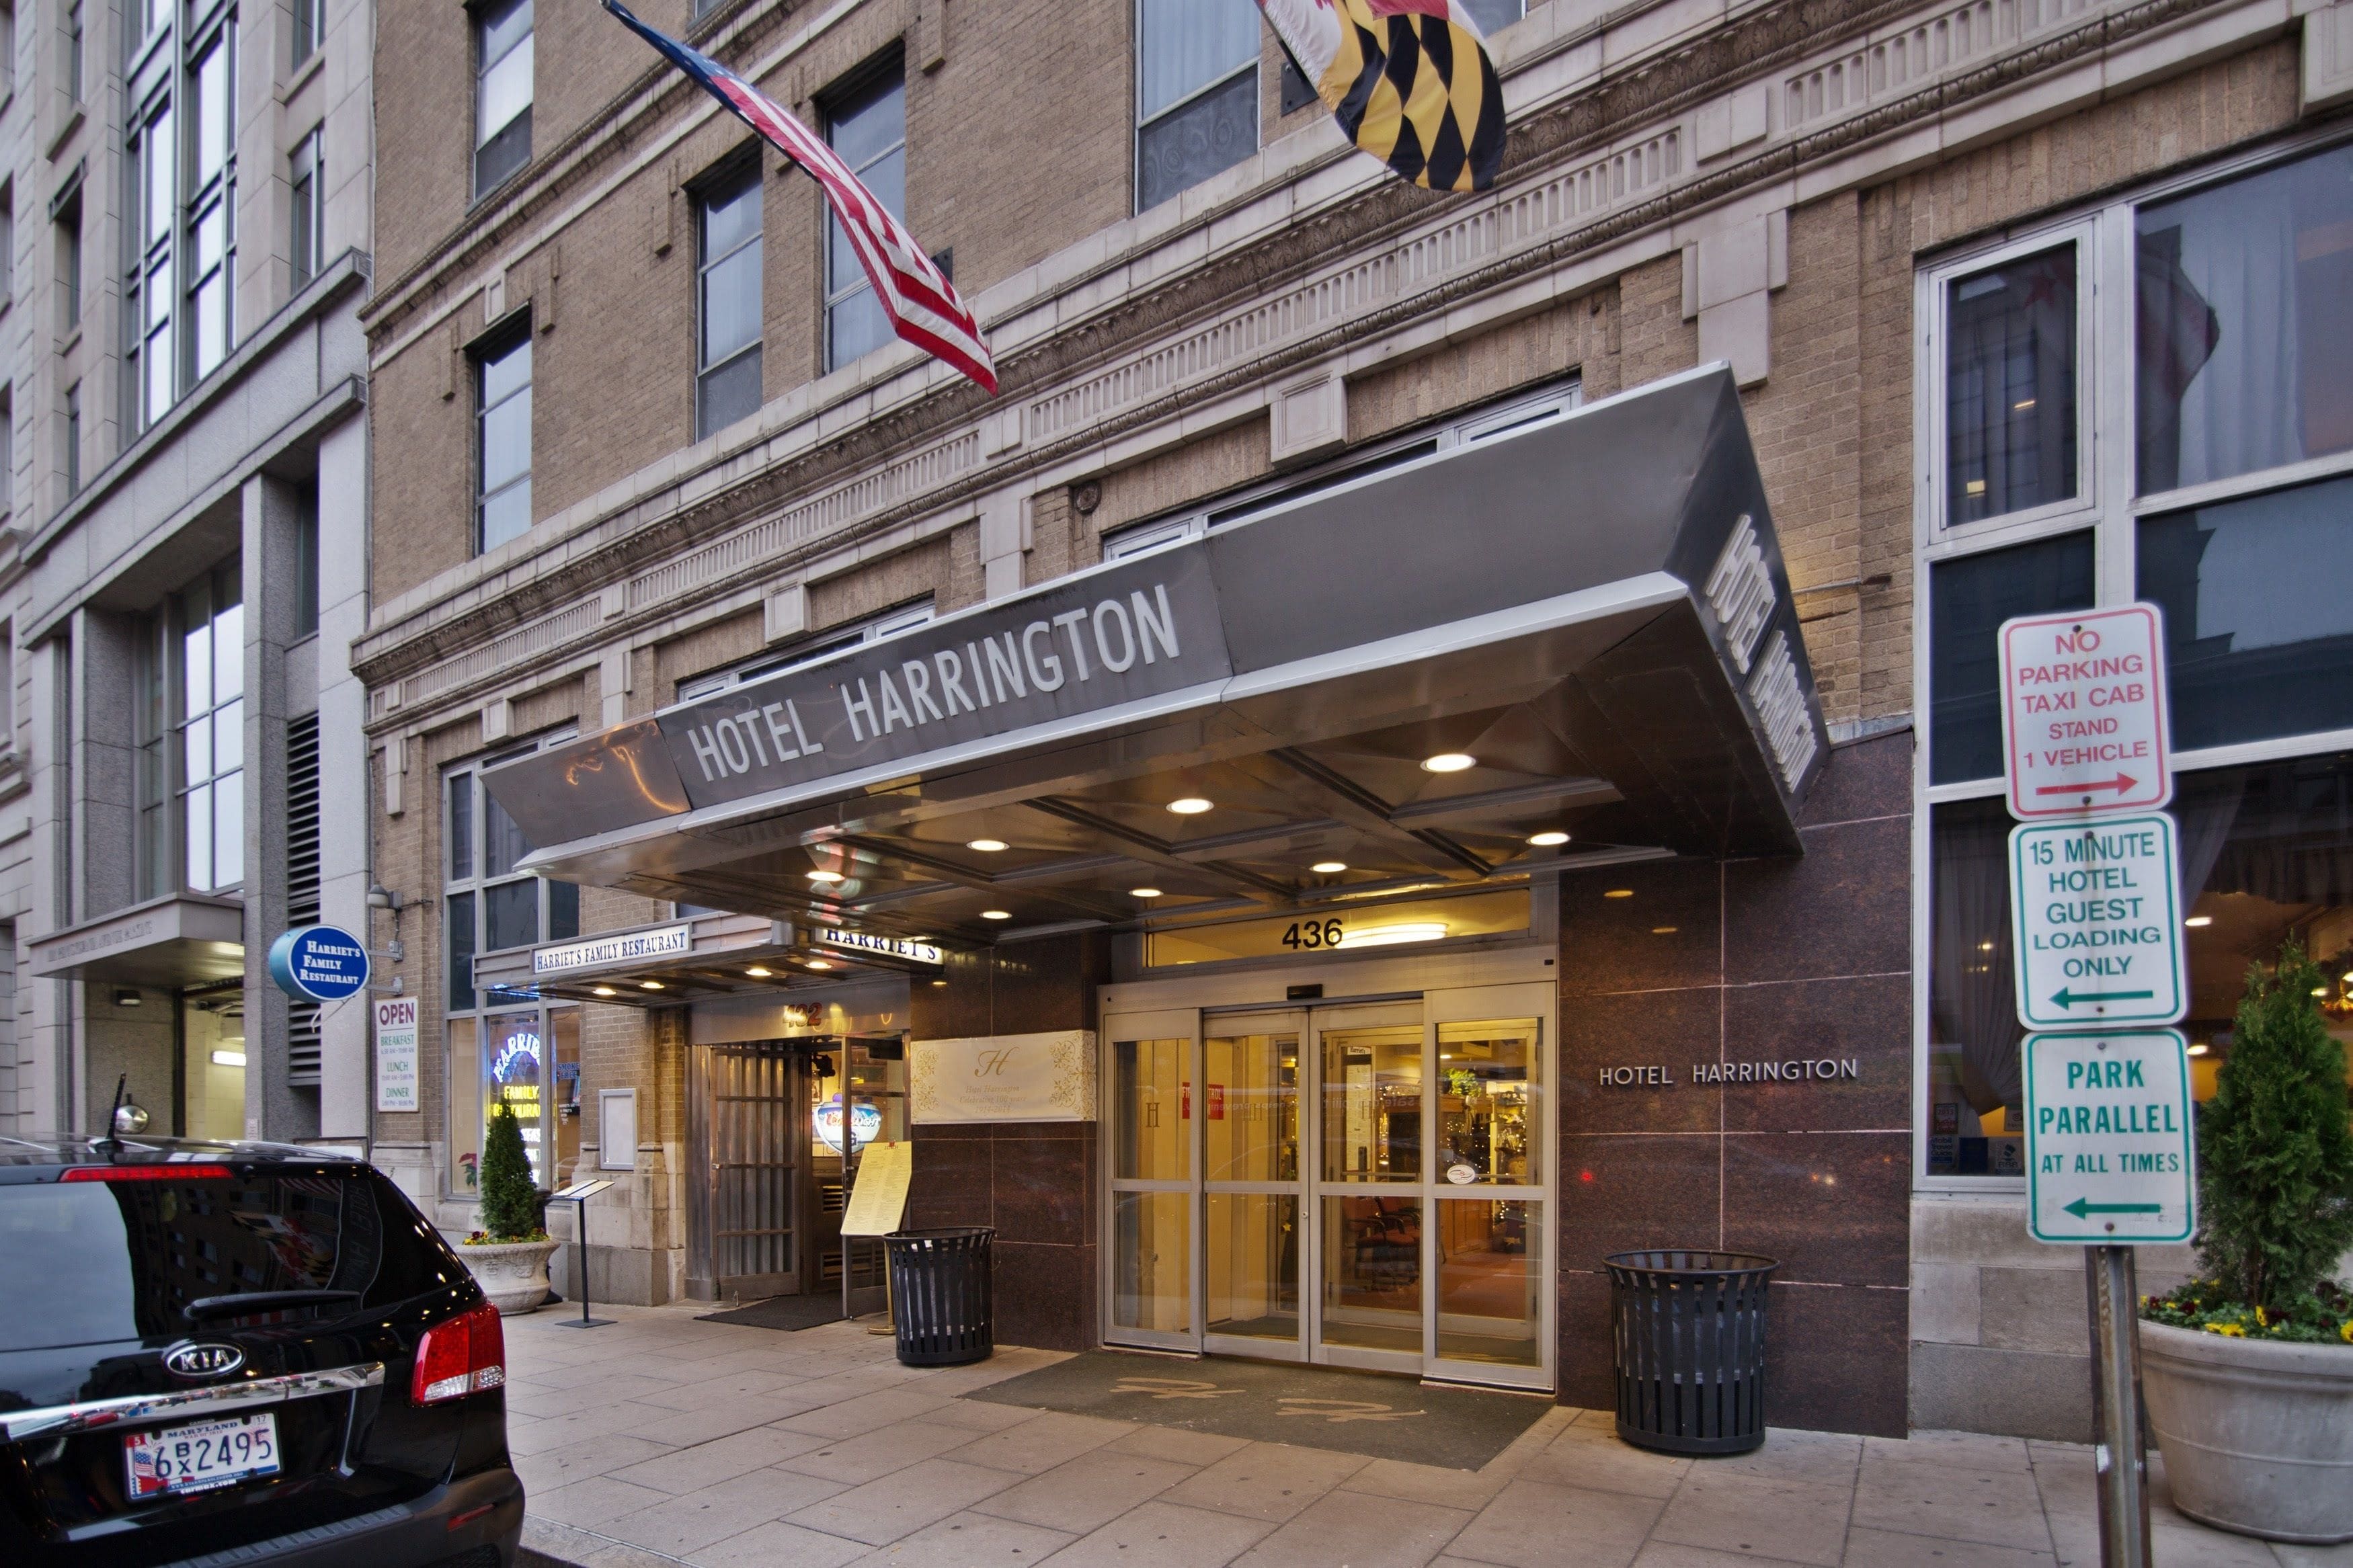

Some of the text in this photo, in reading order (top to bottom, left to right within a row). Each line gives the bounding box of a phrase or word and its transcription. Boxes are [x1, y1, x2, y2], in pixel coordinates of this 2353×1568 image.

[2055, 630, 2101, 655] NO
[2018, 655, 2144, 686] PARKING
[687, 584, 1181, 783] HOTEL HARRINGTON
[2020, 683, 2145, 714] TAXI CAB
[2048, 717, 2118, 740] STAND
[2024, 741, 2149, 768] 1 VEHICLE
[2028, 831, 2155, 866] 15 MINUTE
[2048, 867, 2138, 893] HOTEL
[2045, 897, 2144, 925] GUEST
[1282, 918, 1343, 950] 436
[2034, 926, 2161, 950] LOADING
[303, 954, 342, 970] FAMILY
[537, 932, 686, 970] HARRIET'S FAMILY RESTAURANT
[299, 968, 359, 985] RESTAURANT
[2063, 956, 2132, 978] ONLY
[379, 1002, 414, 1026] OPEN
[381, 1034, 414, 1046] BREAKFAST
[387, 1061, 409, 1072] LUNCH
[974, 1046, 1020, 1077] H
[1599, 1058, 1857, 1085] HOTEL HARRINGTON
[2067, 1060, 2145, 1089] PARK
[386, 1087, 409, 1098] DINNER
[2038, 1104, 2178, 1134] PARALLEL
[2041, 1153, 2179, 1173] AT ALL TIMES
[180, 1349, 231, 1371] KIA
[168, 1421, 238, 1438] MARYLAND
[257, 1415, 267, 1423] 17
[134, 1437, 141, 1445] 5
[180, 1479, 237, 1494] carmax.com
